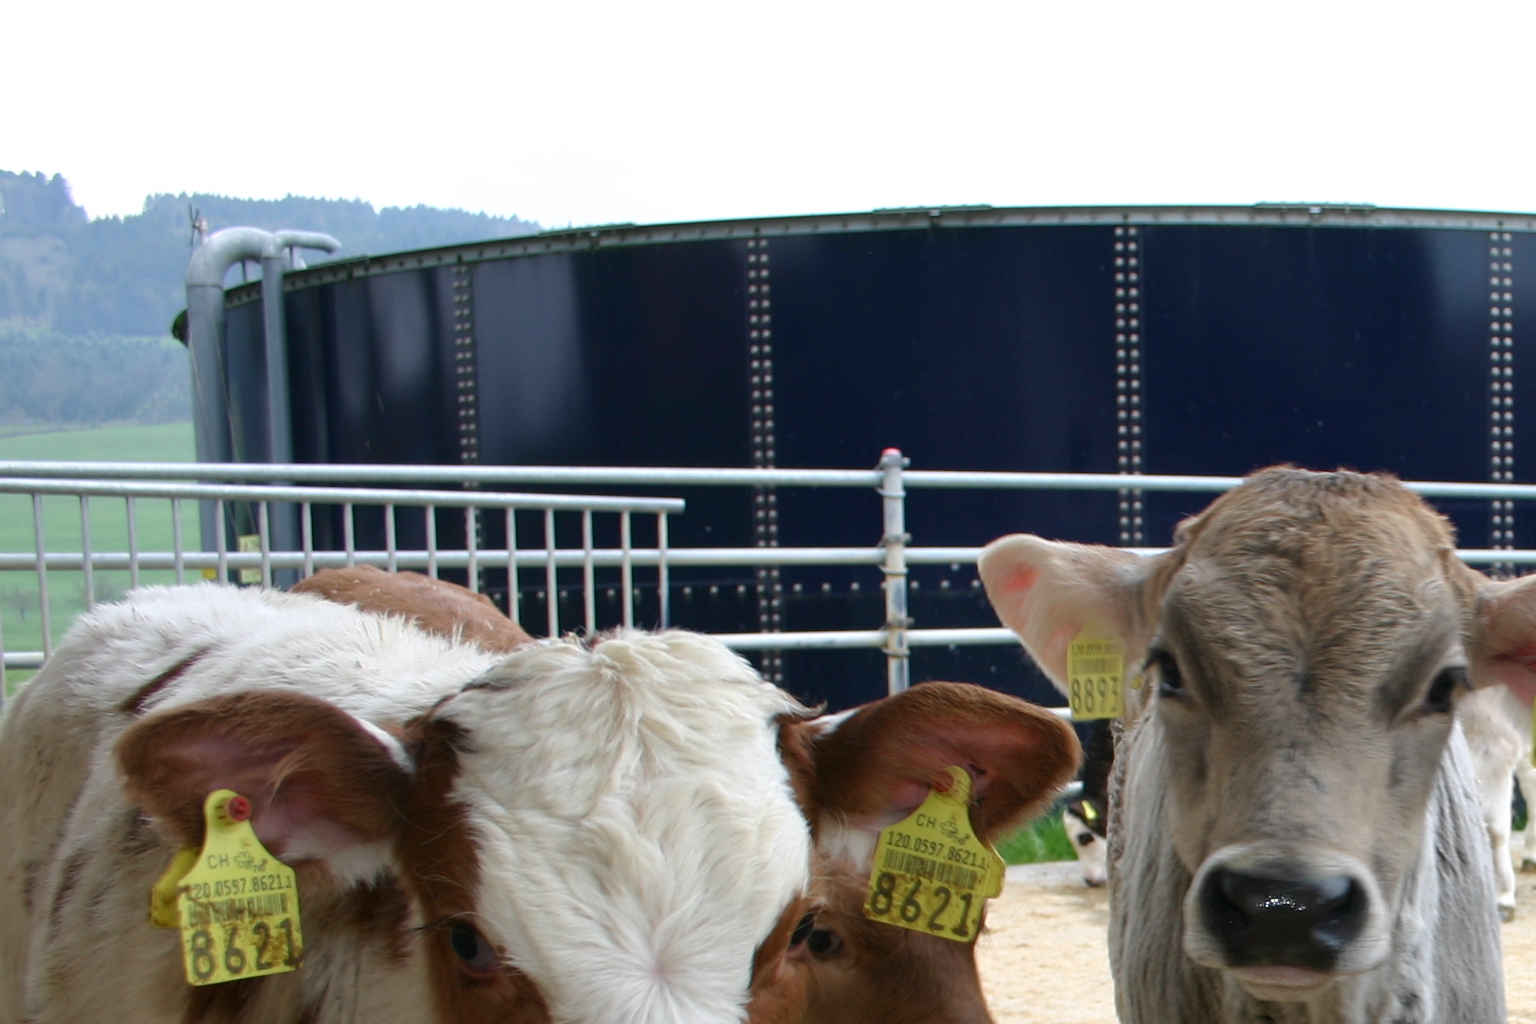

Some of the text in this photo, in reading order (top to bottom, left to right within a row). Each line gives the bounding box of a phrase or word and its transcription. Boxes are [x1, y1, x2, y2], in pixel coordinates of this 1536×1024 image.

[915, 813, 937, 829] CH
[207, 854, 230, 869] CH
[870, 871, 973, 937] 8621
[191, 917, 303, 979] 8621
